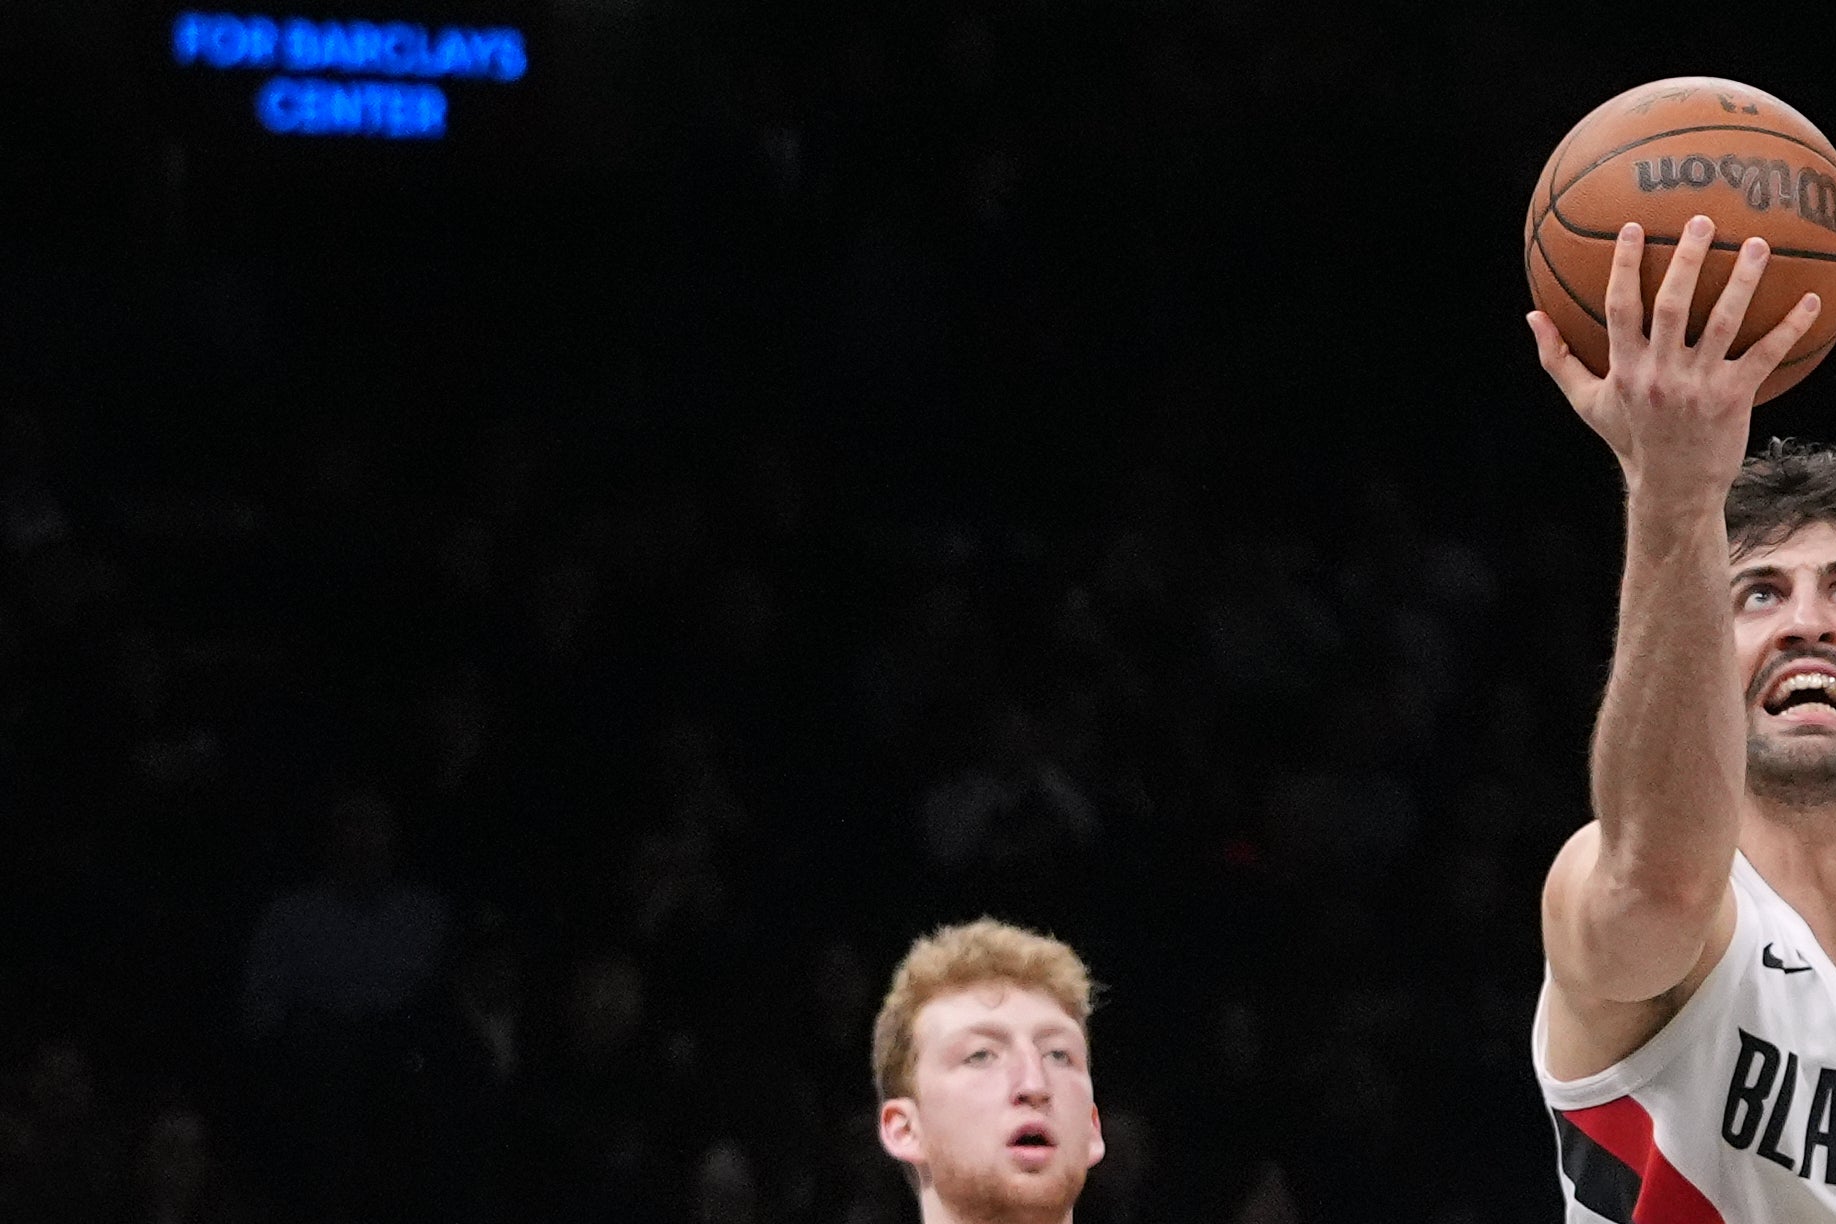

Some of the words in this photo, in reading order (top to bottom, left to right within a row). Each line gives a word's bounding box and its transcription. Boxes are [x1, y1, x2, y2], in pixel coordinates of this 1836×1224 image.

[174, 12, 279, 69] FOR
[281, 16, 528, 82] BARCLAYS
[257, 75, 448, 138] CENTER
